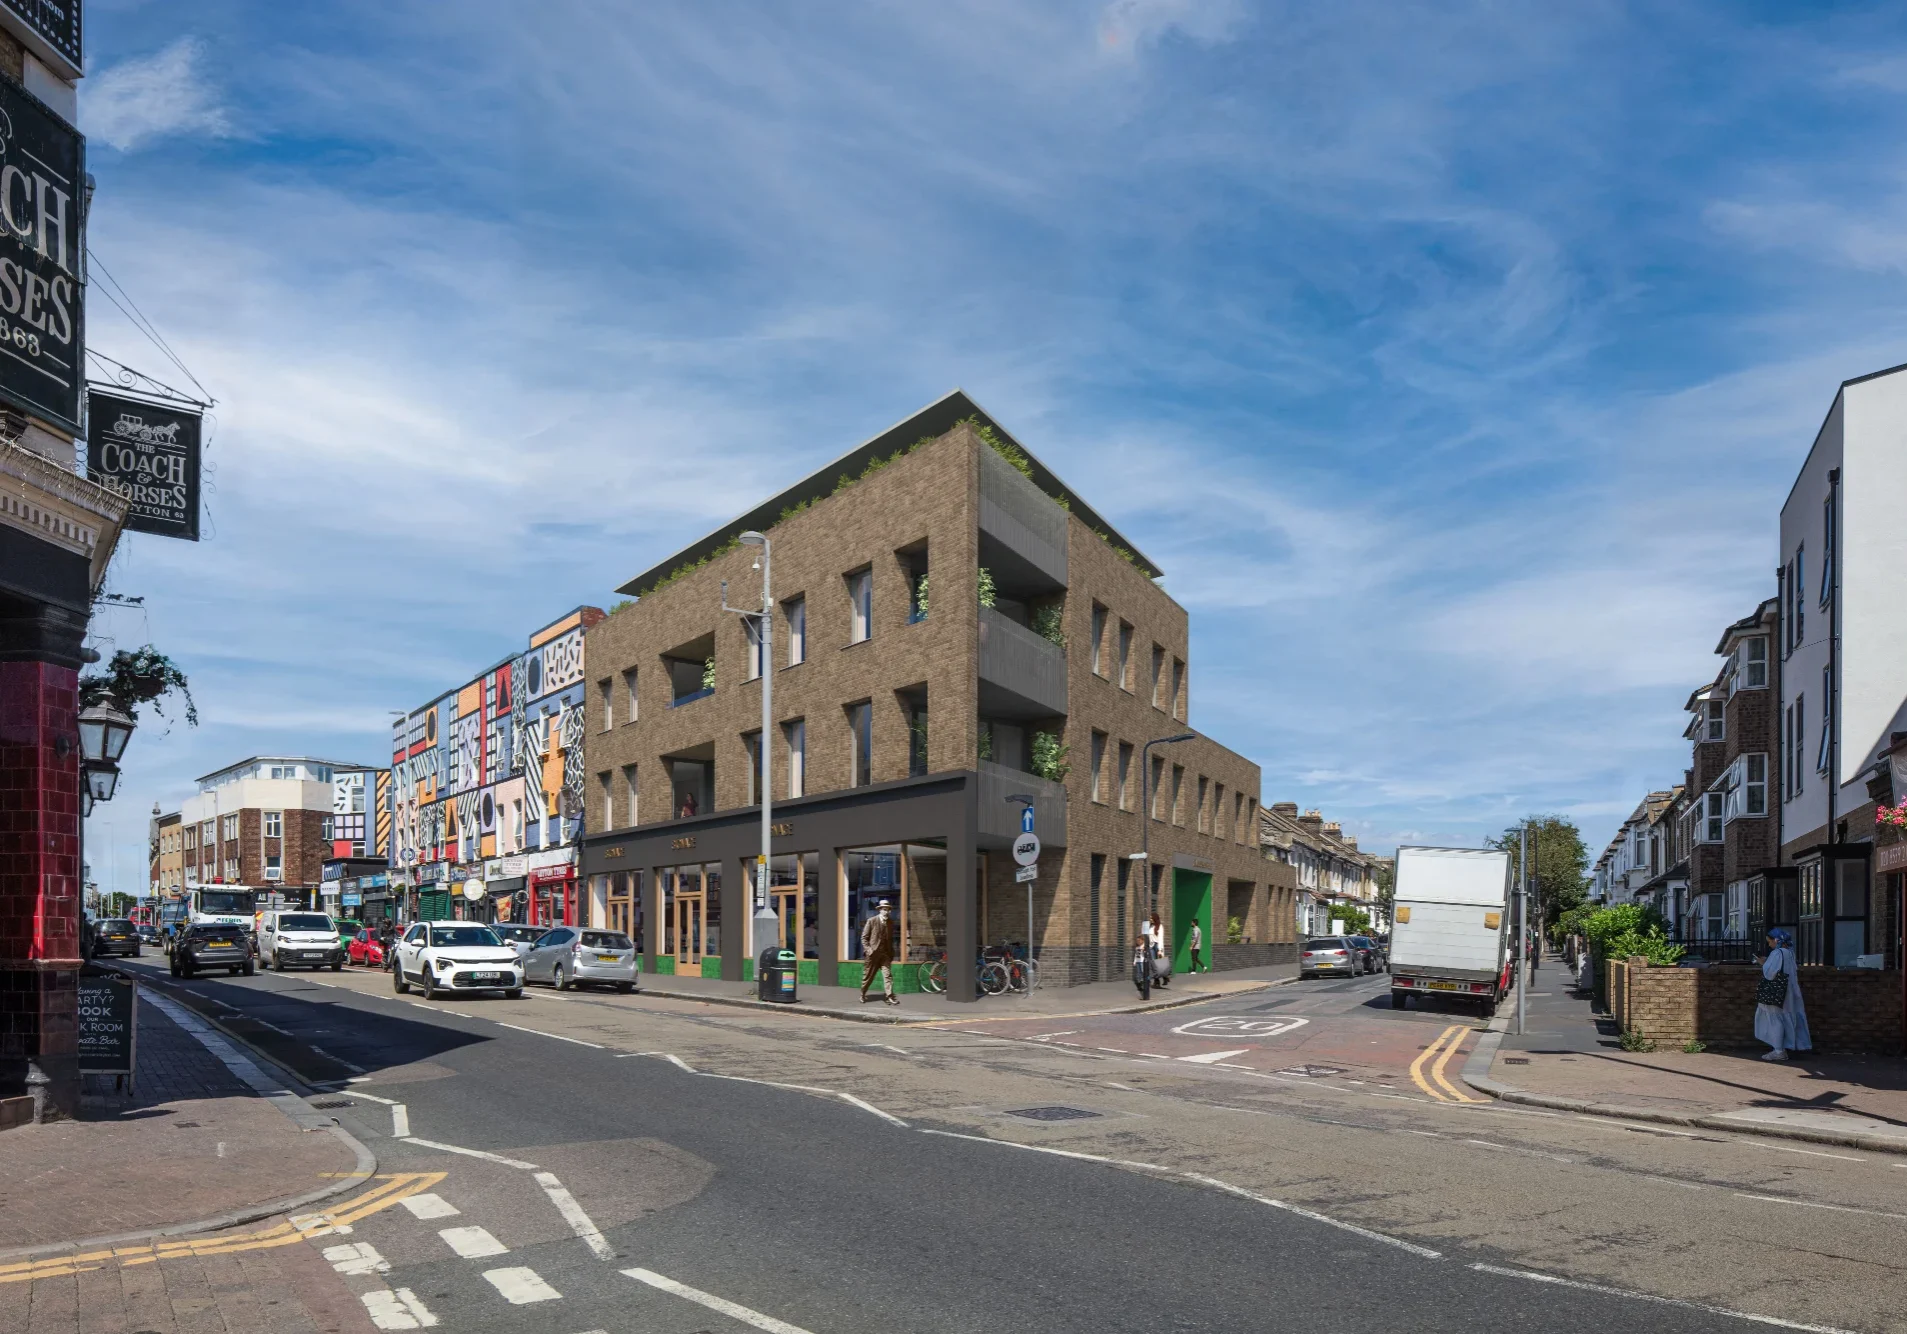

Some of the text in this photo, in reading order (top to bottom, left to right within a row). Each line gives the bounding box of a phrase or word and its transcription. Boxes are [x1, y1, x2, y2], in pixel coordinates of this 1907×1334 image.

[0, 164, 73, 276] CH
[134, 442, 155, 454] THE
[101, 443, 187, 487] COACH
[137, 473, 153, 484] &
[91, 1023, 123, 1032] ROOM
[1199, 1020, 1285, 1030] 20
